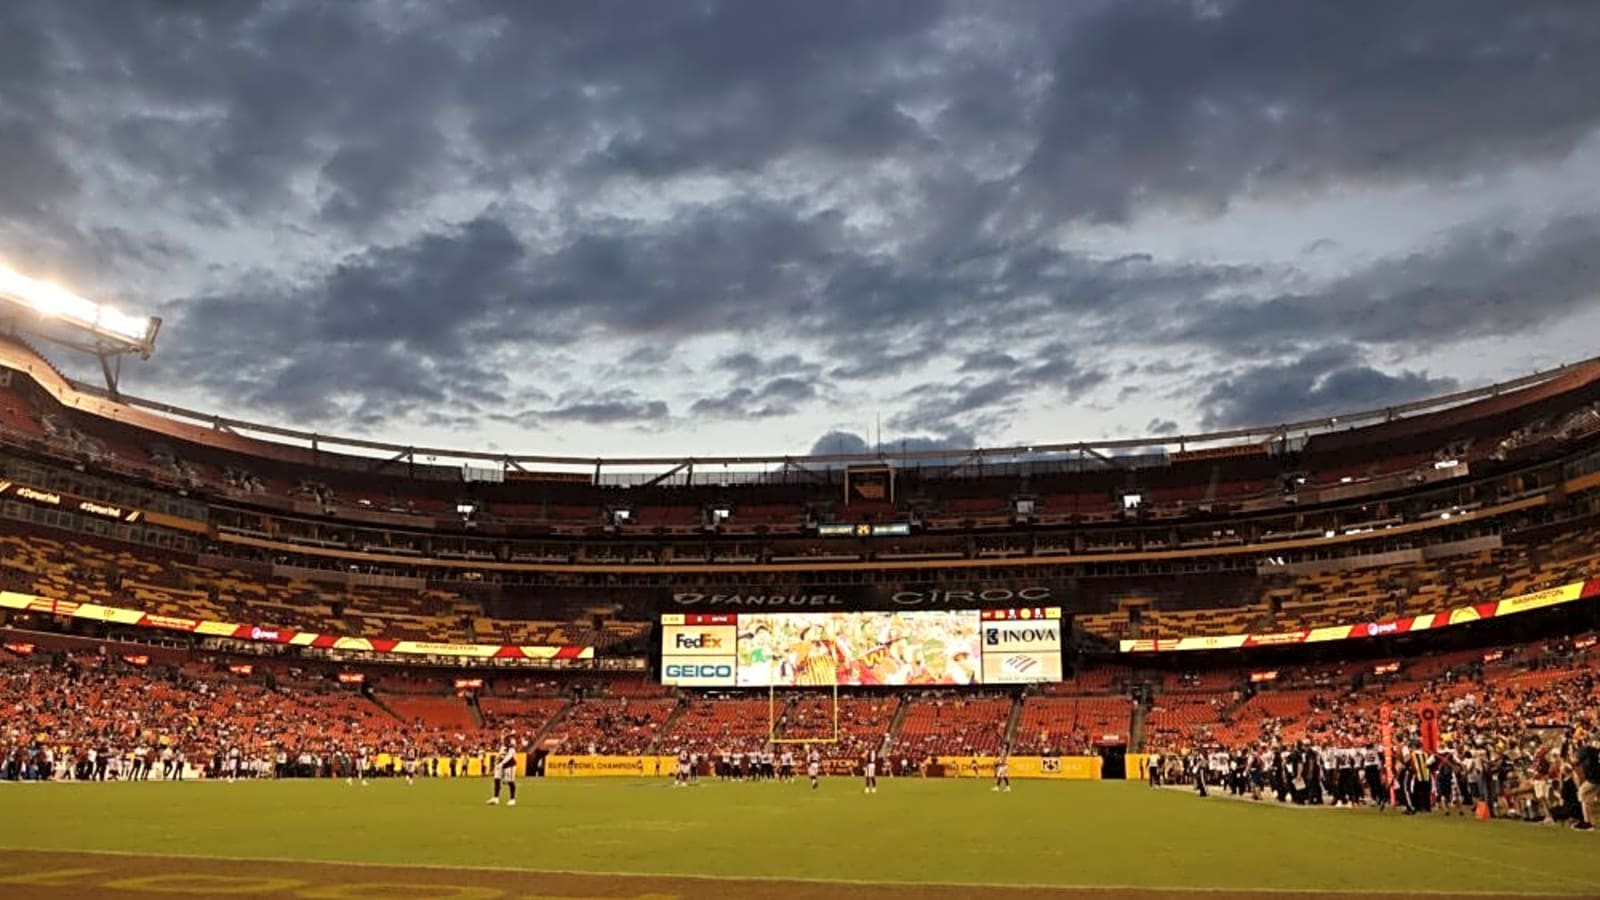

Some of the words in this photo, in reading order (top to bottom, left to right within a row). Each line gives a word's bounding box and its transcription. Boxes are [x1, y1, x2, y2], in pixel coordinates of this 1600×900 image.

[709, 593, 844, 606] FANDUEL
[676, 633, 722, 648] FedEx
[1003, 628, 1057, 643] INOVA
[666, 664, 732, 678] GEICO
